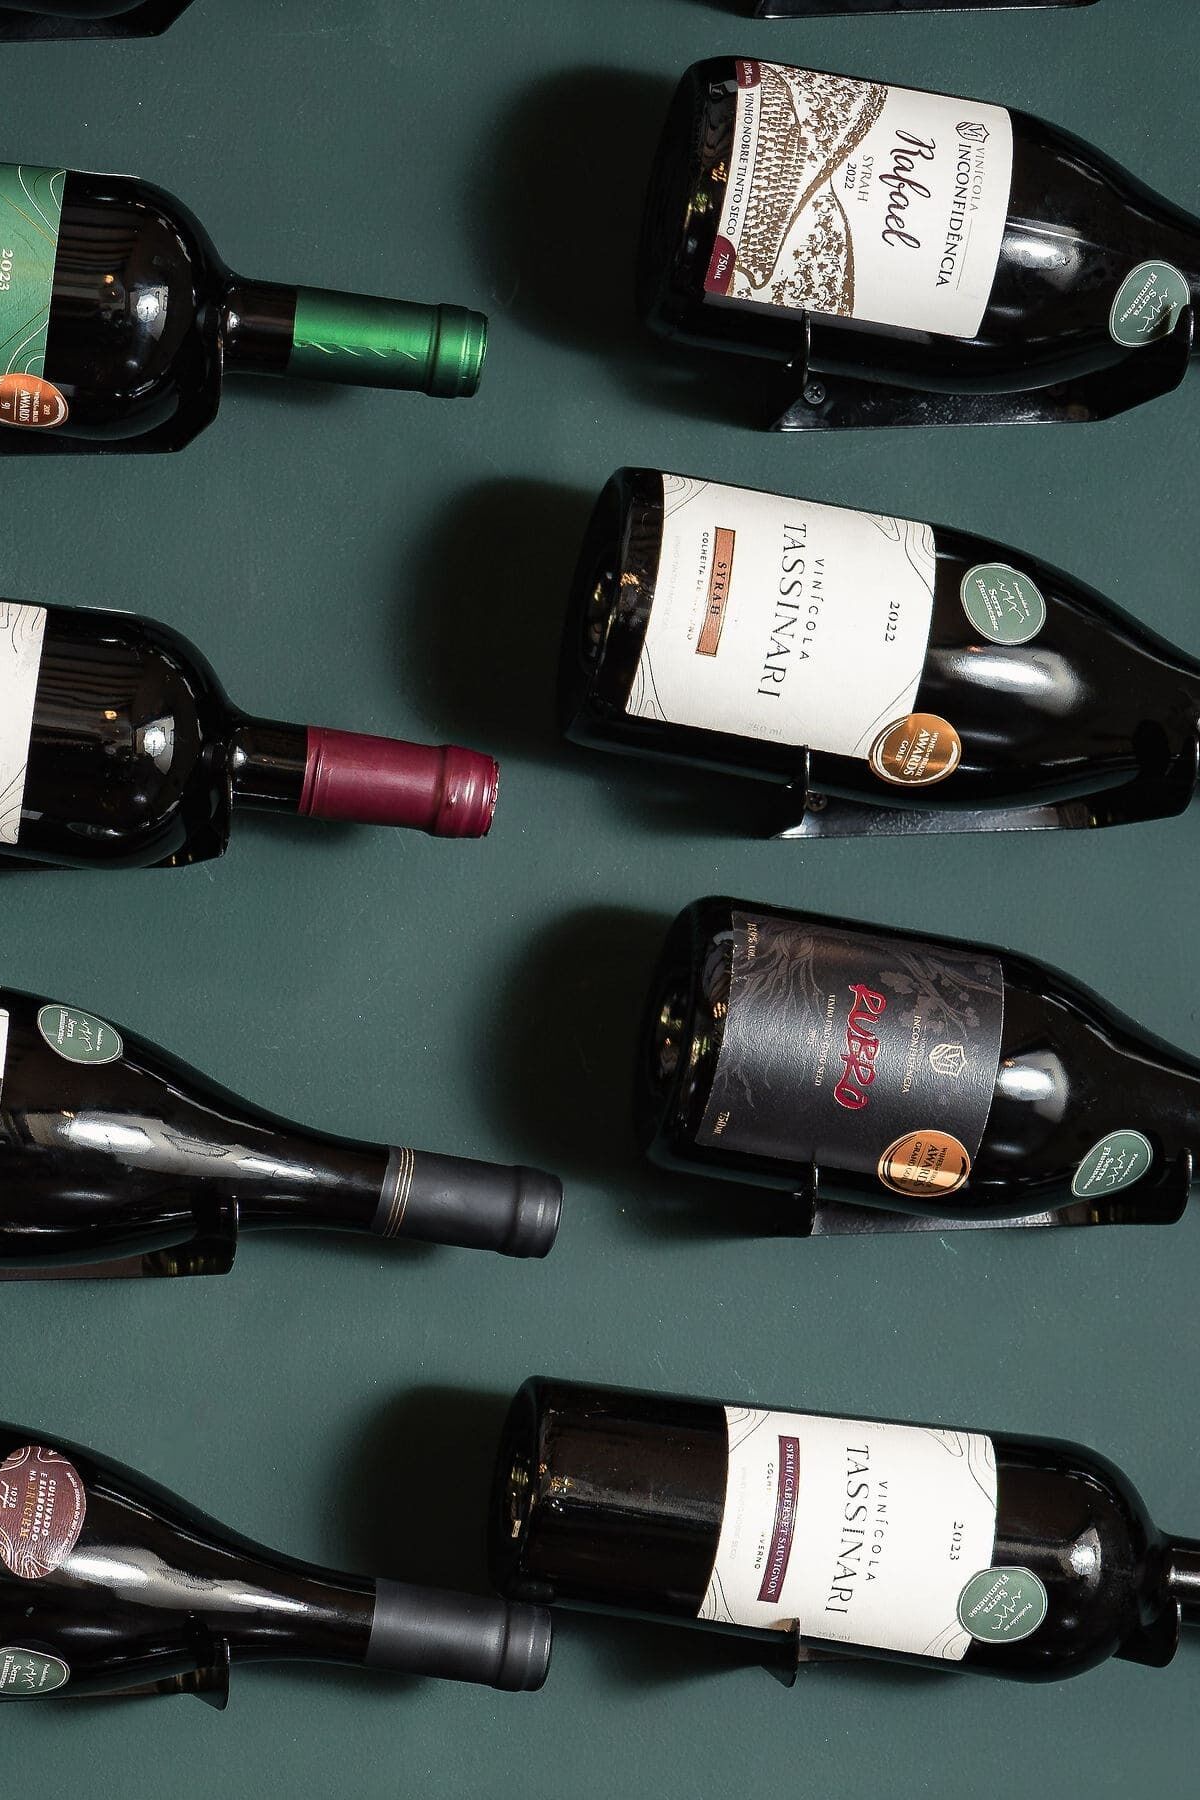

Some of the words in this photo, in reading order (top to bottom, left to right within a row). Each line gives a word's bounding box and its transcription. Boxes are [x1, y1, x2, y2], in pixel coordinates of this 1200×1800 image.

[741, 93, 755, 124] VINHO
[737, 127, 751, 162] NOBRE
[731, 165, 747, 202] TINTO
[844, 163, 858, 190] 2022
[858, 154, 874, 202] SYRAH
[879, 130, 935, 249] Rafael
[725, 206, 740, 235] SECO
[935, 143, 972, 288] INCONFIDÊNCIA
[0, 248, 13, 291] 2023
[19, 390, 31, 421] AWARDS
[709, 562, 728, 616] SYRAH
[756, 523, 807, 699] TASSINARI
[799, 558, 825, 661] VINÍCOLA
[884, 601, 901, 642] 2022
[895, 740, 909, 761] GOLD
[902, 729, 930, 776] AWARDS
[833, 983, 887, 1110] RUBRO
[9, 1487, 17, 1508] 1028
[29, 1470, 36, 1481] NA
[32, 1480, 47, 1541] ELABORADO
[42, 1480, 56, 1536] CULTIVADO
[825, 1445, 870, 1614] TASSINARI
[866, 1481, 889, 1581] VINÍCOLA
[949, 1521, 963, 1561] 2023
[767, 1537, 787, 1595] SAUVIGNON
